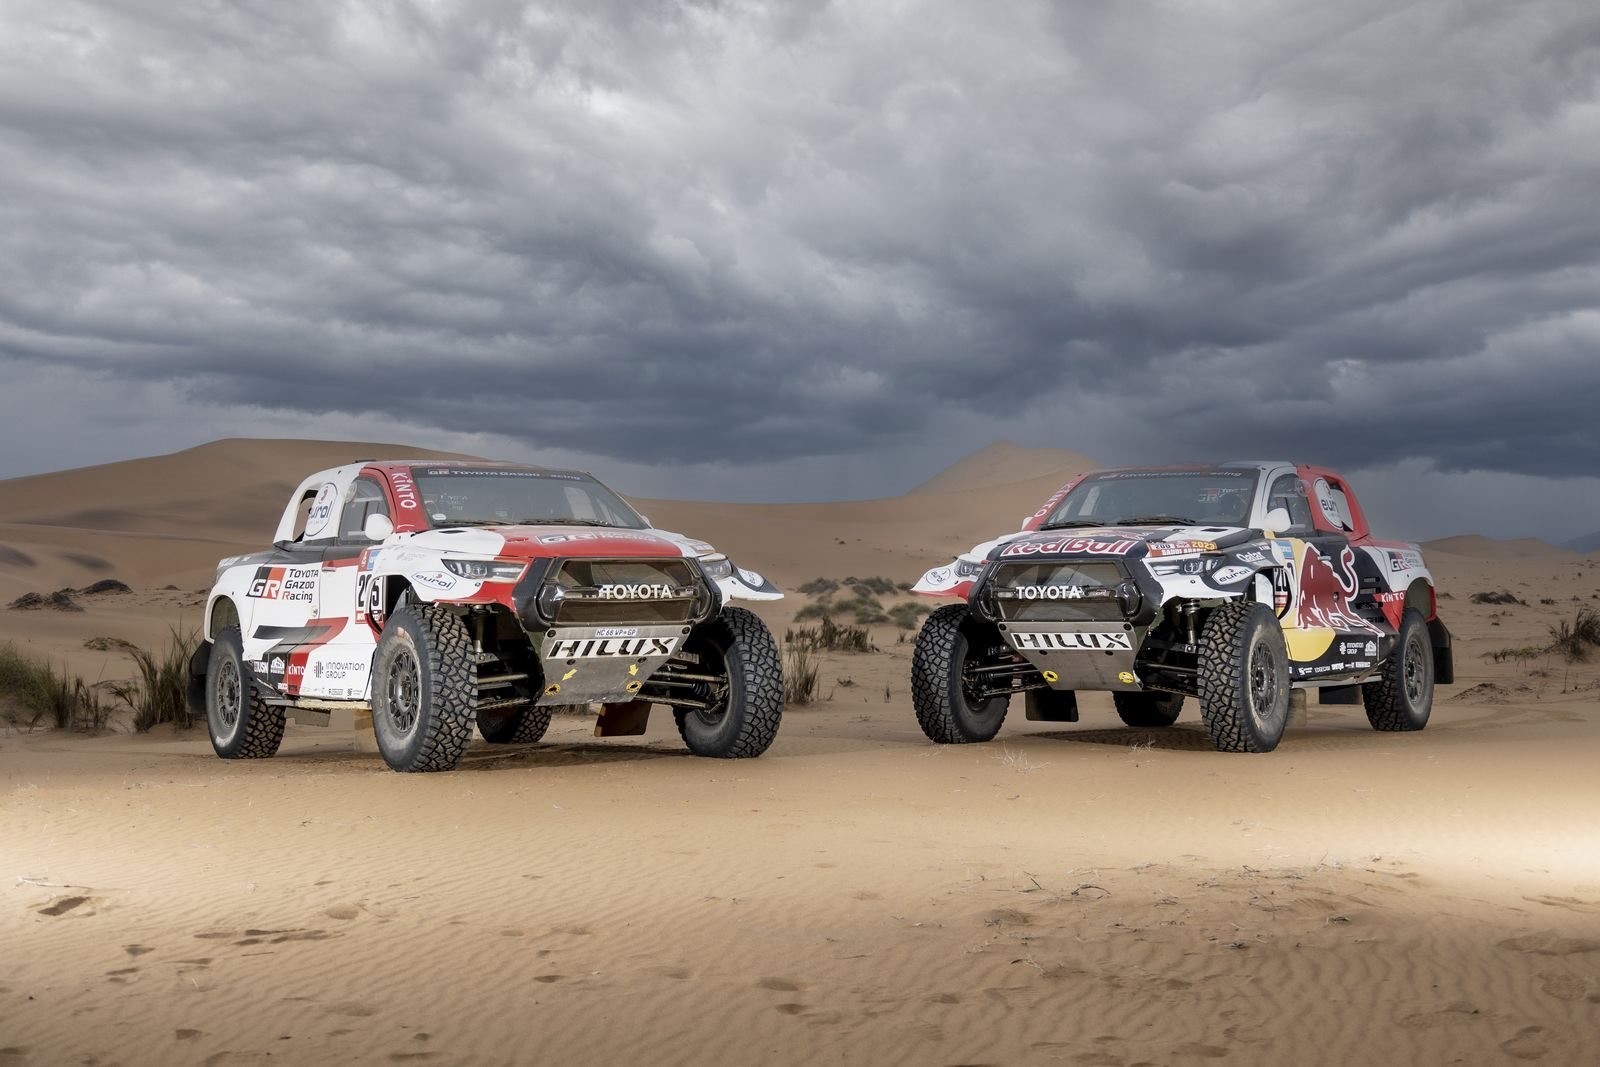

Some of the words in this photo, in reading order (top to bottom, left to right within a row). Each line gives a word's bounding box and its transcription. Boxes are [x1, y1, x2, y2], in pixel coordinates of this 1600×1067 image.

[1001, 538, 1069, 556] Red
[1062, 537, 1139, 555] Bull
[289, 568, 319, 579] TOYOTA
[415, 574, 453, 588] eurol
[246, 578, 282, 600] GR
[285, 580, 315, 590] GAZOO
[604, 584, 673, 600] TOYOTA
[1015, 585, 1082, 600] TOYOTA
[281, 590, 313, 604] Racing
[549, 639, 674, 658] HILUX
[1012, 633, 1131, 649] HILUX
